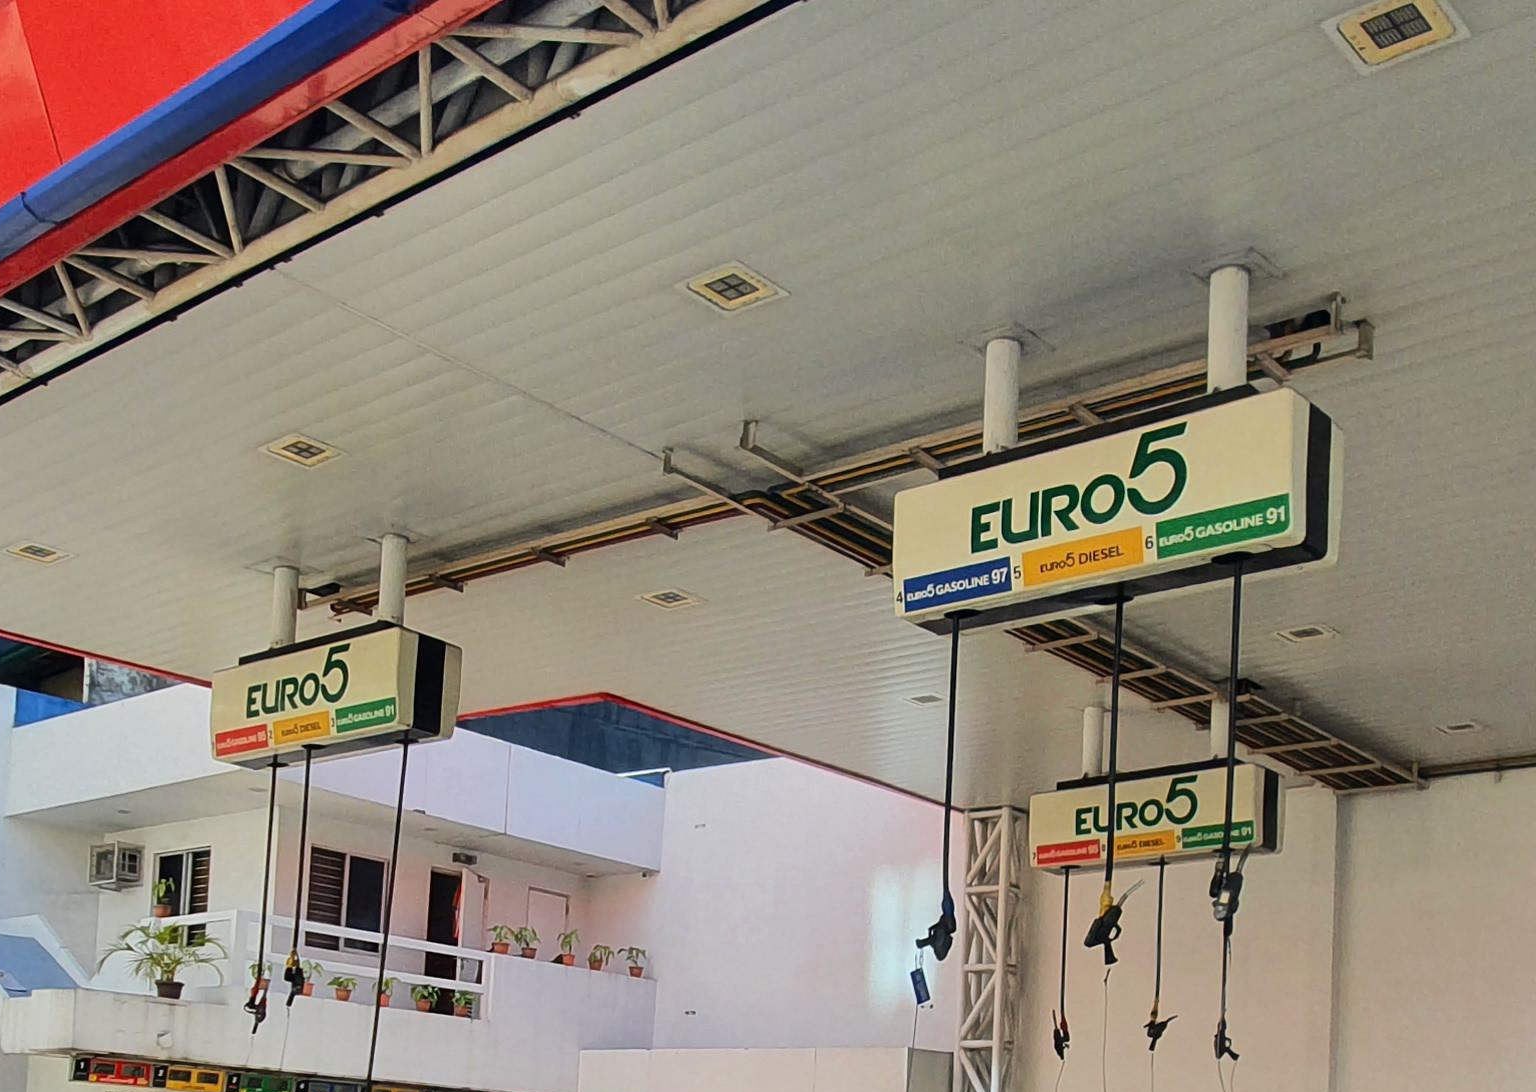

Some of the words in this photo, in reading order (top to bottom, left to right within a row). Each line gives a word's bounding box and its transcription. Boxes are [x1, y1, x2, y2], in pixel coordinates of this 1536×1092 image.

[970, 421, 1188, 554] EURO5
[1159, 526, 1194, 547] EURO5
[1196, 514, 1264, 538] GASOLINE
[1266, 505, 1286, 524] 91
[1145, 535, 1154, 549] 6
[1040, 552, 1075, 573] EURO5
[1078, 545, 1124, 565] DIESEL
[1014, 565, 1021, 580] 5
[906, 583, 935, 602] EURO5
[935, 574, 990, 595] GASOLINE
[991, 566, 1008, 584] 97
[896, 591, 903, 604] 4
[246, 643, 351, 719] EURO5
[385, 704, 395, 717] 91
[299, 721, 322, 733] DIESEL
[1075, 775, 1198, 835] EURO5
[1203, 828, 1240, 841] GASONE
[1138, 837, 1165, 849] DIESEL
